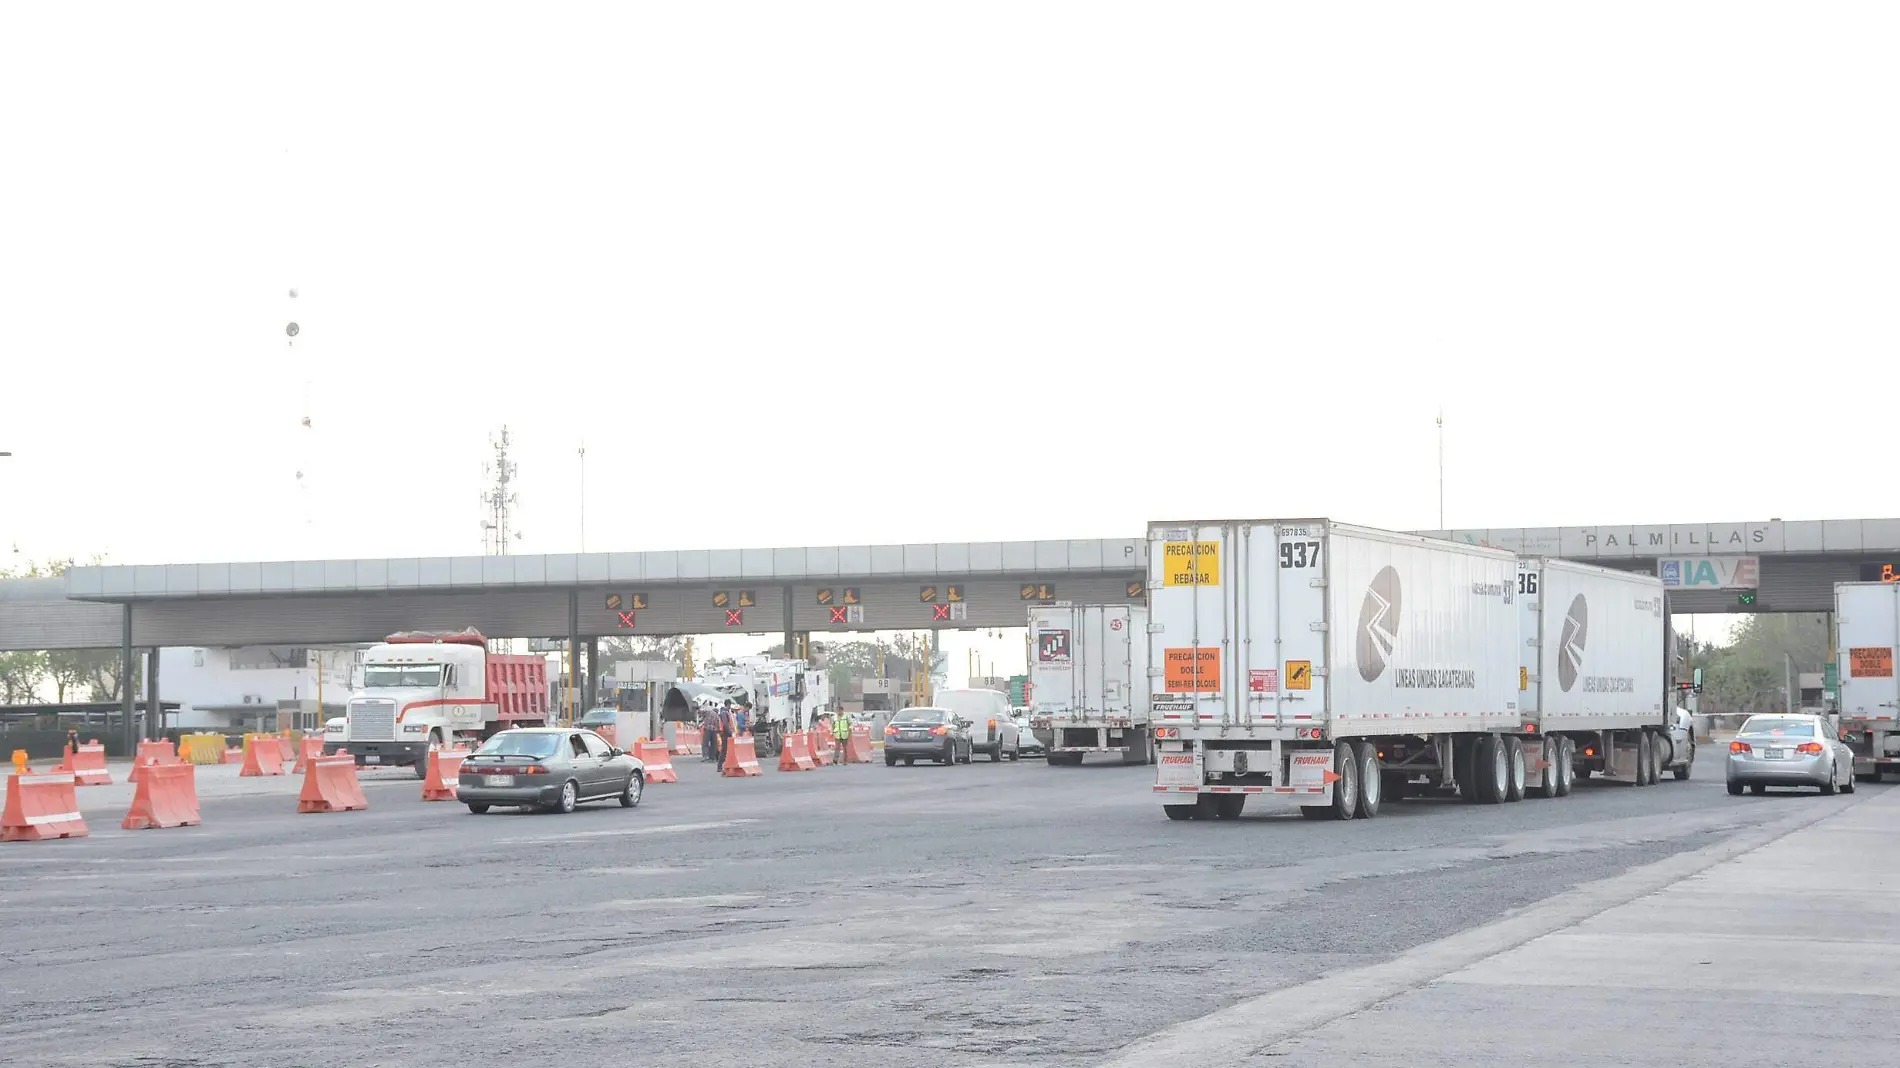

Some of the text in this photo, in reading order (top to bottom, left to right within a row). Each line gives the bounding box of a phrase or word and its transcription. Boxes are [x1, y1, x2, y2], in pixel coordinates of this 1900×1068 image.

[1280, 542, 1320, 568] 937
[1174, 572, 1210, 585] REBASAR
[1683, 559, 1758, 586] IAVE
[1043, 635, 1065, 656] JIT
[1395, 668, 1475, 689] LINEAS UNIDAS ZACATECANAS
[1161, 755, 1194, 765] FRUEHAU
[1293, 756, 1330, 765] FRUEHAUF
